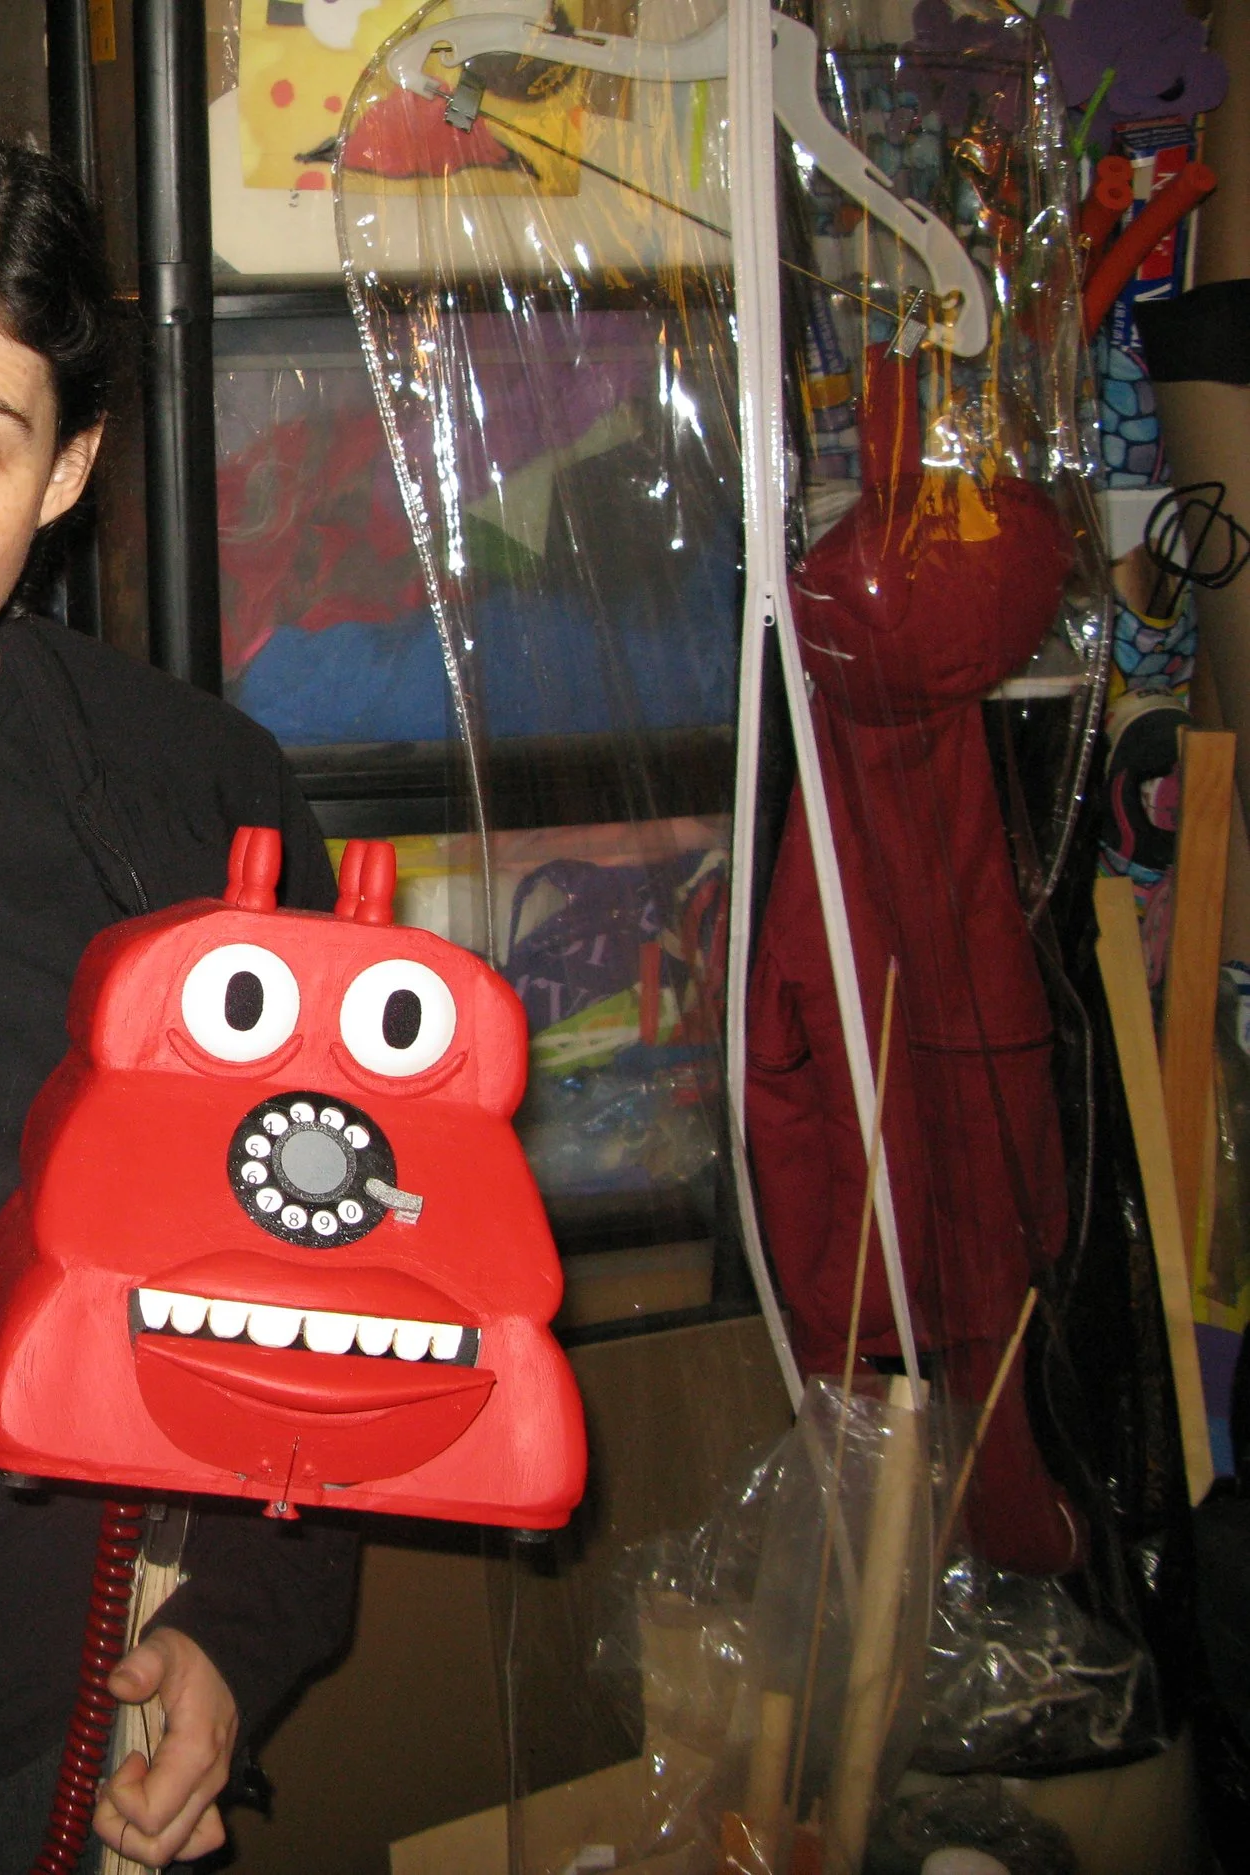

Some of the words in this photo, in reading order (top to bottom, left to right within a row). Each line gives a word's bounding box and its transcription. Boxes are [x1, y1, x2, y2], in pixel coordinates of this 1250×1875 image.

[293, 1110, 302, 1124] 3
[323, 1114, 332, 1126] 2
[264, 1120, 275, 1135] 4
[348, 1131, 354, 1145] 1
[250, 1143, 259, 1157] 5
[247, 1170, 258, 1185] 6
[263, 1195, 274, 1210] 7
[346, 1204, 356, 1219] 0
[288, 1212, 299, 1227] 8
[319, 1215, 330, 1230] 9
